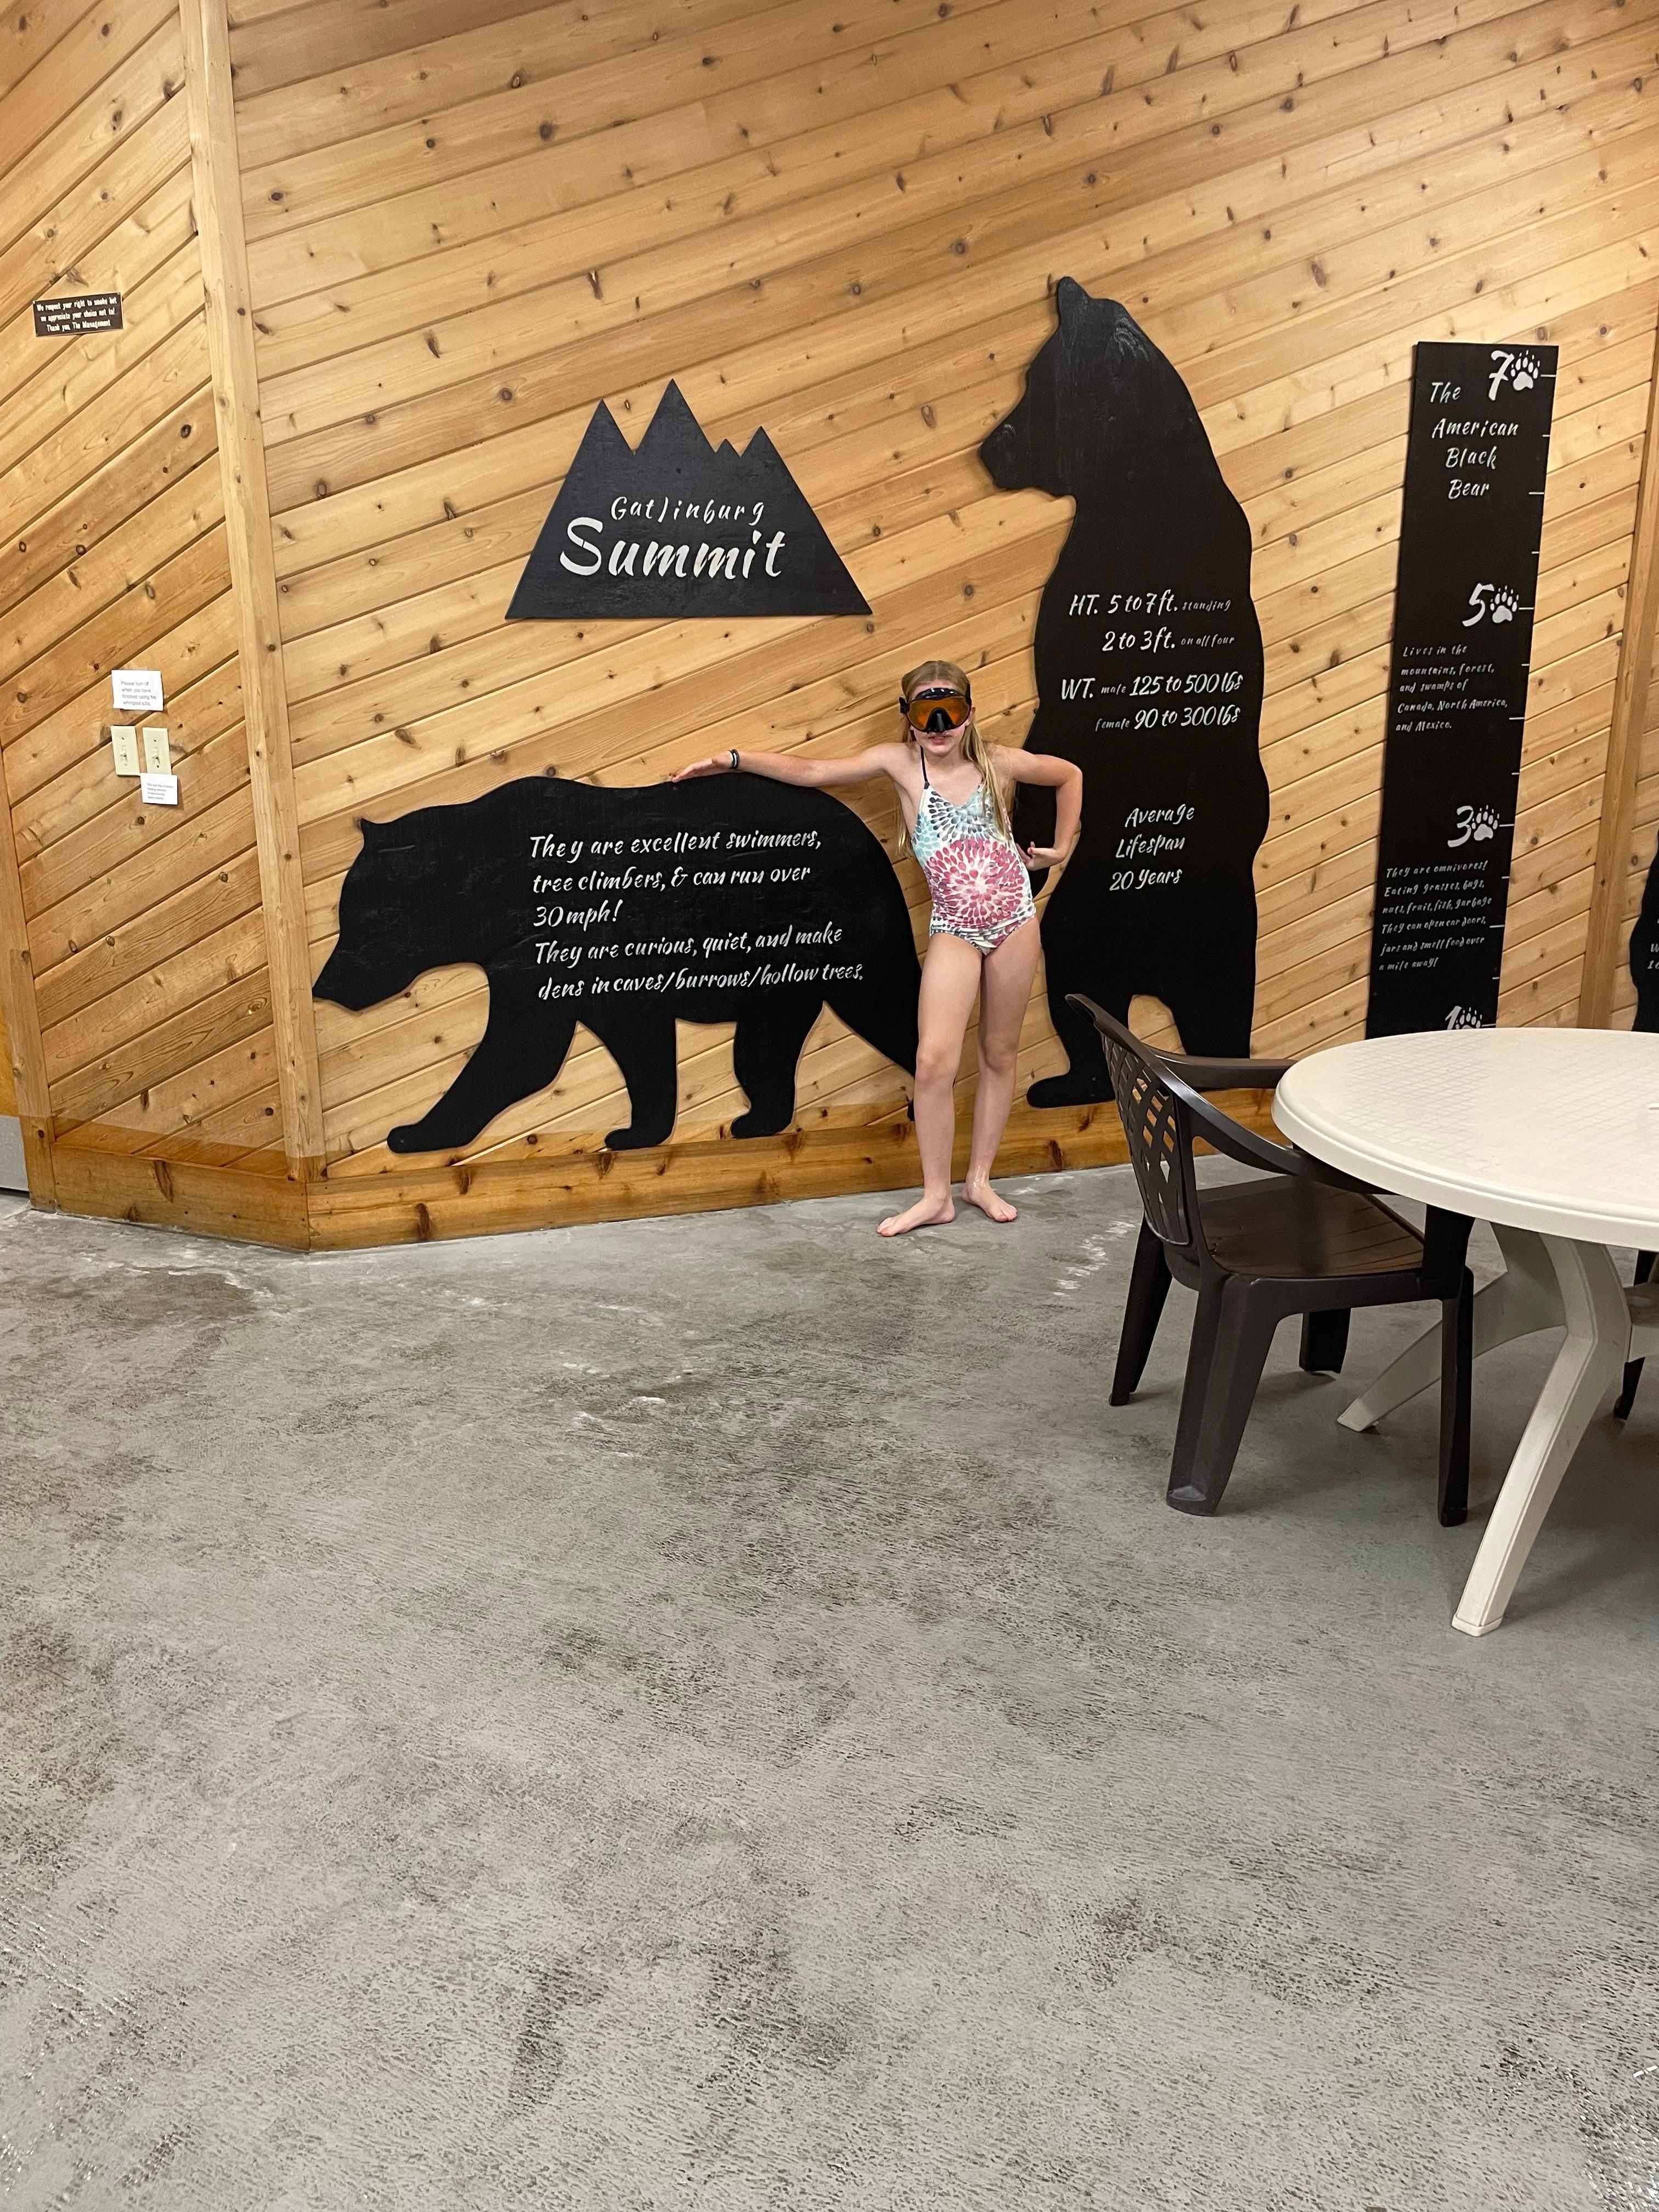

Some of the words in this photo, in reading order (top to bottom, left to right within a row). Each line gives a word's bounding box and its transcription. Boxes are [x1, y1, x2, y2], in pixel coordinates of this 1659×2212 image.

[1488, 350, 1515, 401] 7
[1430, 381, 1461, 403] The
[1431, 418, 1519, 439] American
[1446, 445, 1497, 470] Black
[1448, 479, 1489, 499] Bear
[611, 496, 764, 526] Gatlinburg
[559, 516, 786, 580] Summit
[1069, 594, 1100, 616] HT.
[1108, 594, 1122, 614] 5
[1125, 595, 1142, 612] to
[1182, 600, 1231, 612] standing
[1462, 583, 1494, 627] 5
[1102, 631, 1115, 651] 2
[1119, 632, 1136, 650] to
[1196, 635, 1211, 647] all
[1211, 634, 1235, 647] four
[1403, 646, 1433, 657] Lives
[1436, 646, 1447, 655] in
[1451, 644, 1468, 655] the
[1401, 666, 1456, 675] mountains,
[1459, 663, 1494, 676] forest,
[1061, 678, 1096, 700] WT.
[1101, 684, 1126, 695] male
[1129, 675, 1164, 696] 125
[1165, 676, 1182, 693] to
[1400, 682, 1417, 693] and
[1420, 680, 1454, 692] swamps
[1457, 679, 1469, 691] of
[1397, 701, 1435, 714] Canada,
[1437, 698, 1468, 711] North
[1469, 698, 1508, 709] America,
[1095, 718, 1130, 732] female
[1134, 708, 1159, 730] 90
[1161, 710, 1178, 727] to
[1395, 721, 1413, 732] and
[1415, 721, 1452, 732] Mexico.
[1125, 804, 1195, 828] Average
[1448, 805, 1474, 848] 3
[530, 833, 584, 864] They
[590, 840, 624, 855] are
[631, 832, 721, 854] excellent
[725, 830, 821, 849] swimmers,
[1115, 833, 1186, 860] Lifespan
[533, 875, 573, 893] tree
[578, 866, 665, 891] climbers,
[670, 866, 689, 887] &
[693, 871, 726, 885] can
[730, 870, 764, 884] run
[770, 867, 810, 882] over
[1386, 867, 1410, 878] They
[1434, 860, 1488, 873] omnivores!
[1384, 884, 1419, 897] Eating
[1454, 896, 1492, 909] garbage
[1381, 923, 1405, 934] They
[1424, 919, 1445, 930] open
[535, 940, 583, 969] They
[588, 944, 619, 959] are
[624, 936, 697, 957] curious,
[702, 932, 752, 958] quiet,
[755, 924, 793, 947] and
[795, 921, 843, 945] make
[1380, 943, 1401, 957] jars
[1402, 941, 1418, 951] and
[1420, 939, 1445, 950] smell
[1445, 936, 1465, 949] food
[1387, 960, 1409, 971] mile
[1412, 957, 1439, 968] away!
[538, 977, 585, 1000] dens
[591, 977, 610, 994] in
[822, 963, 863, 980] trees.
